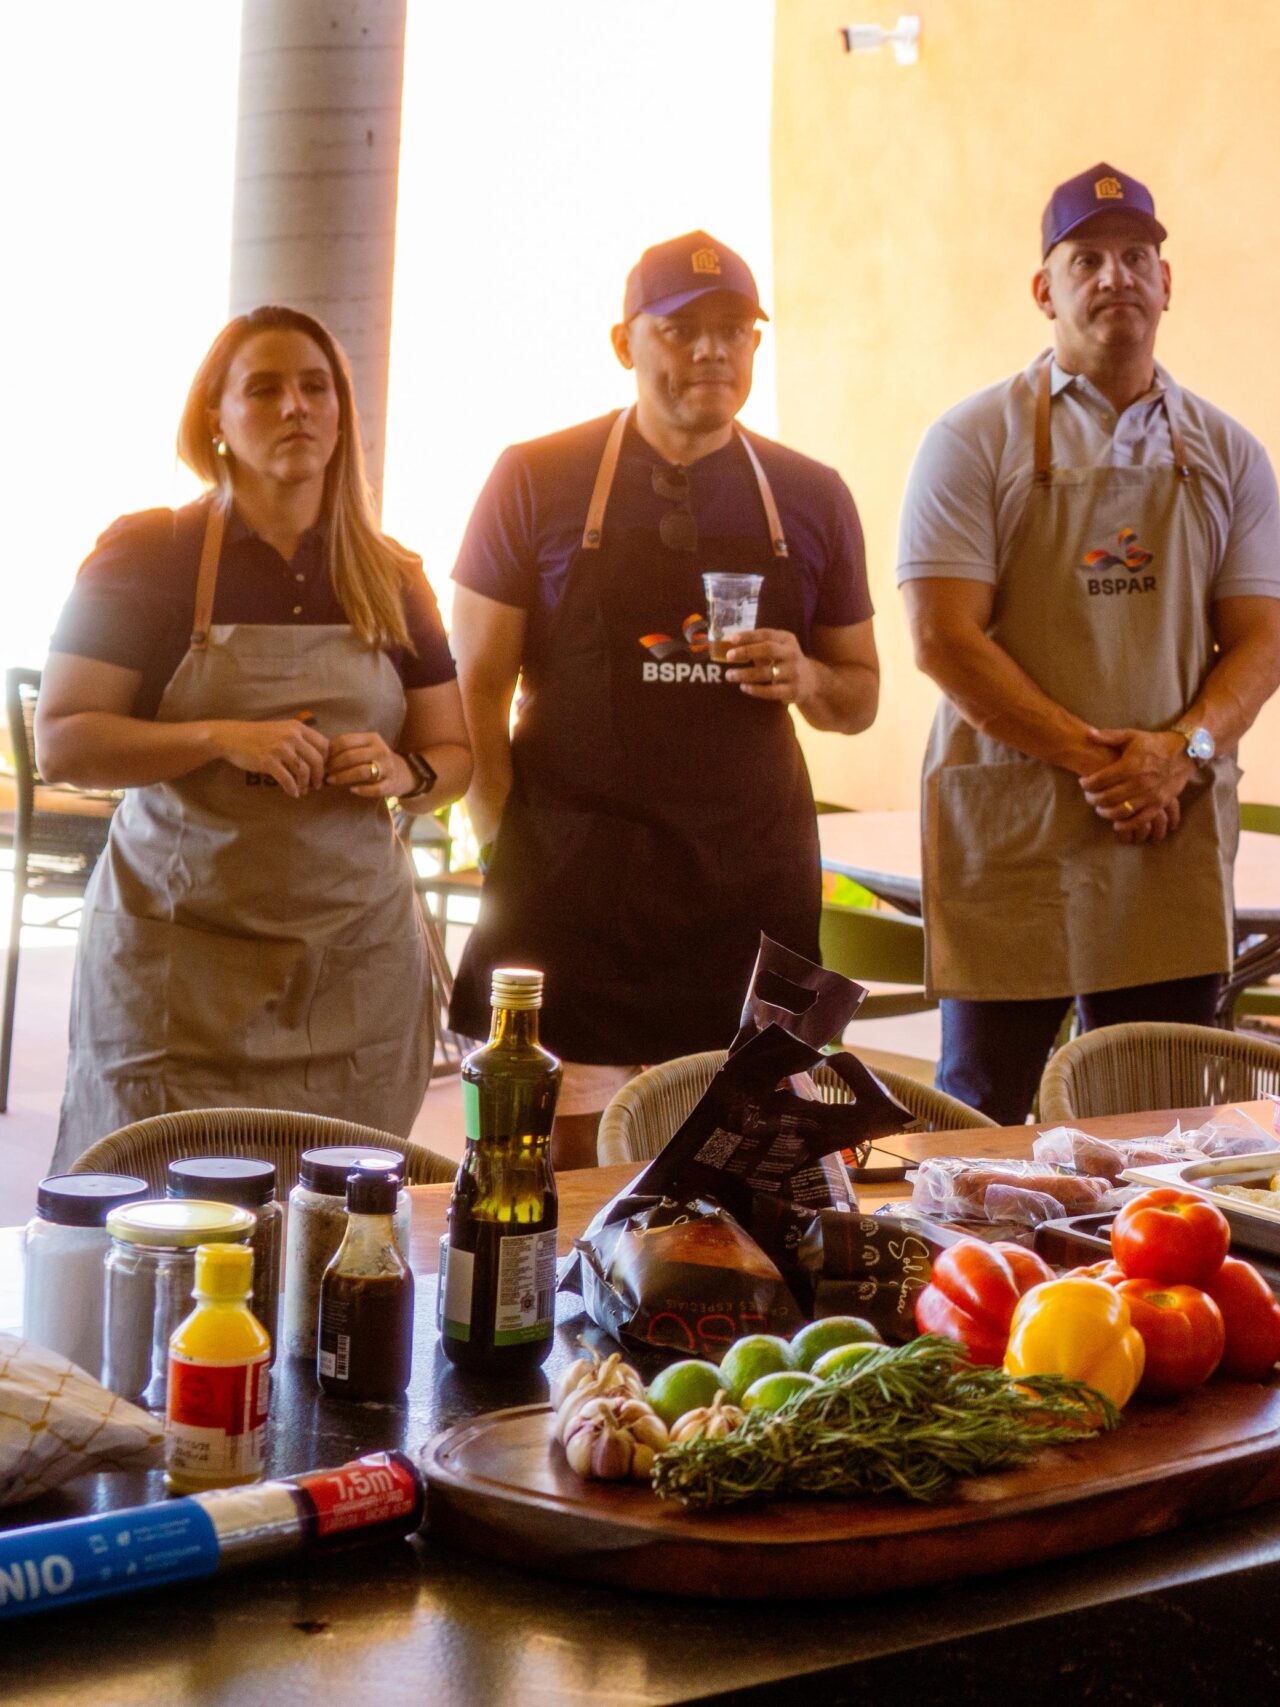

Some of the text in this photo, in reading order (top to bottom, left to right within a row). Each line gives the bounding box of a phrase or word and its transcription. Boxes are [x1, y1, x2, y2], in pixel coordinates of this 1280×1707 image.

[1088, 576, 1157, 596] BSPAR
[642, 661, 722, 684] BSPAR
[888, 1236, 930, 1274] Sol
